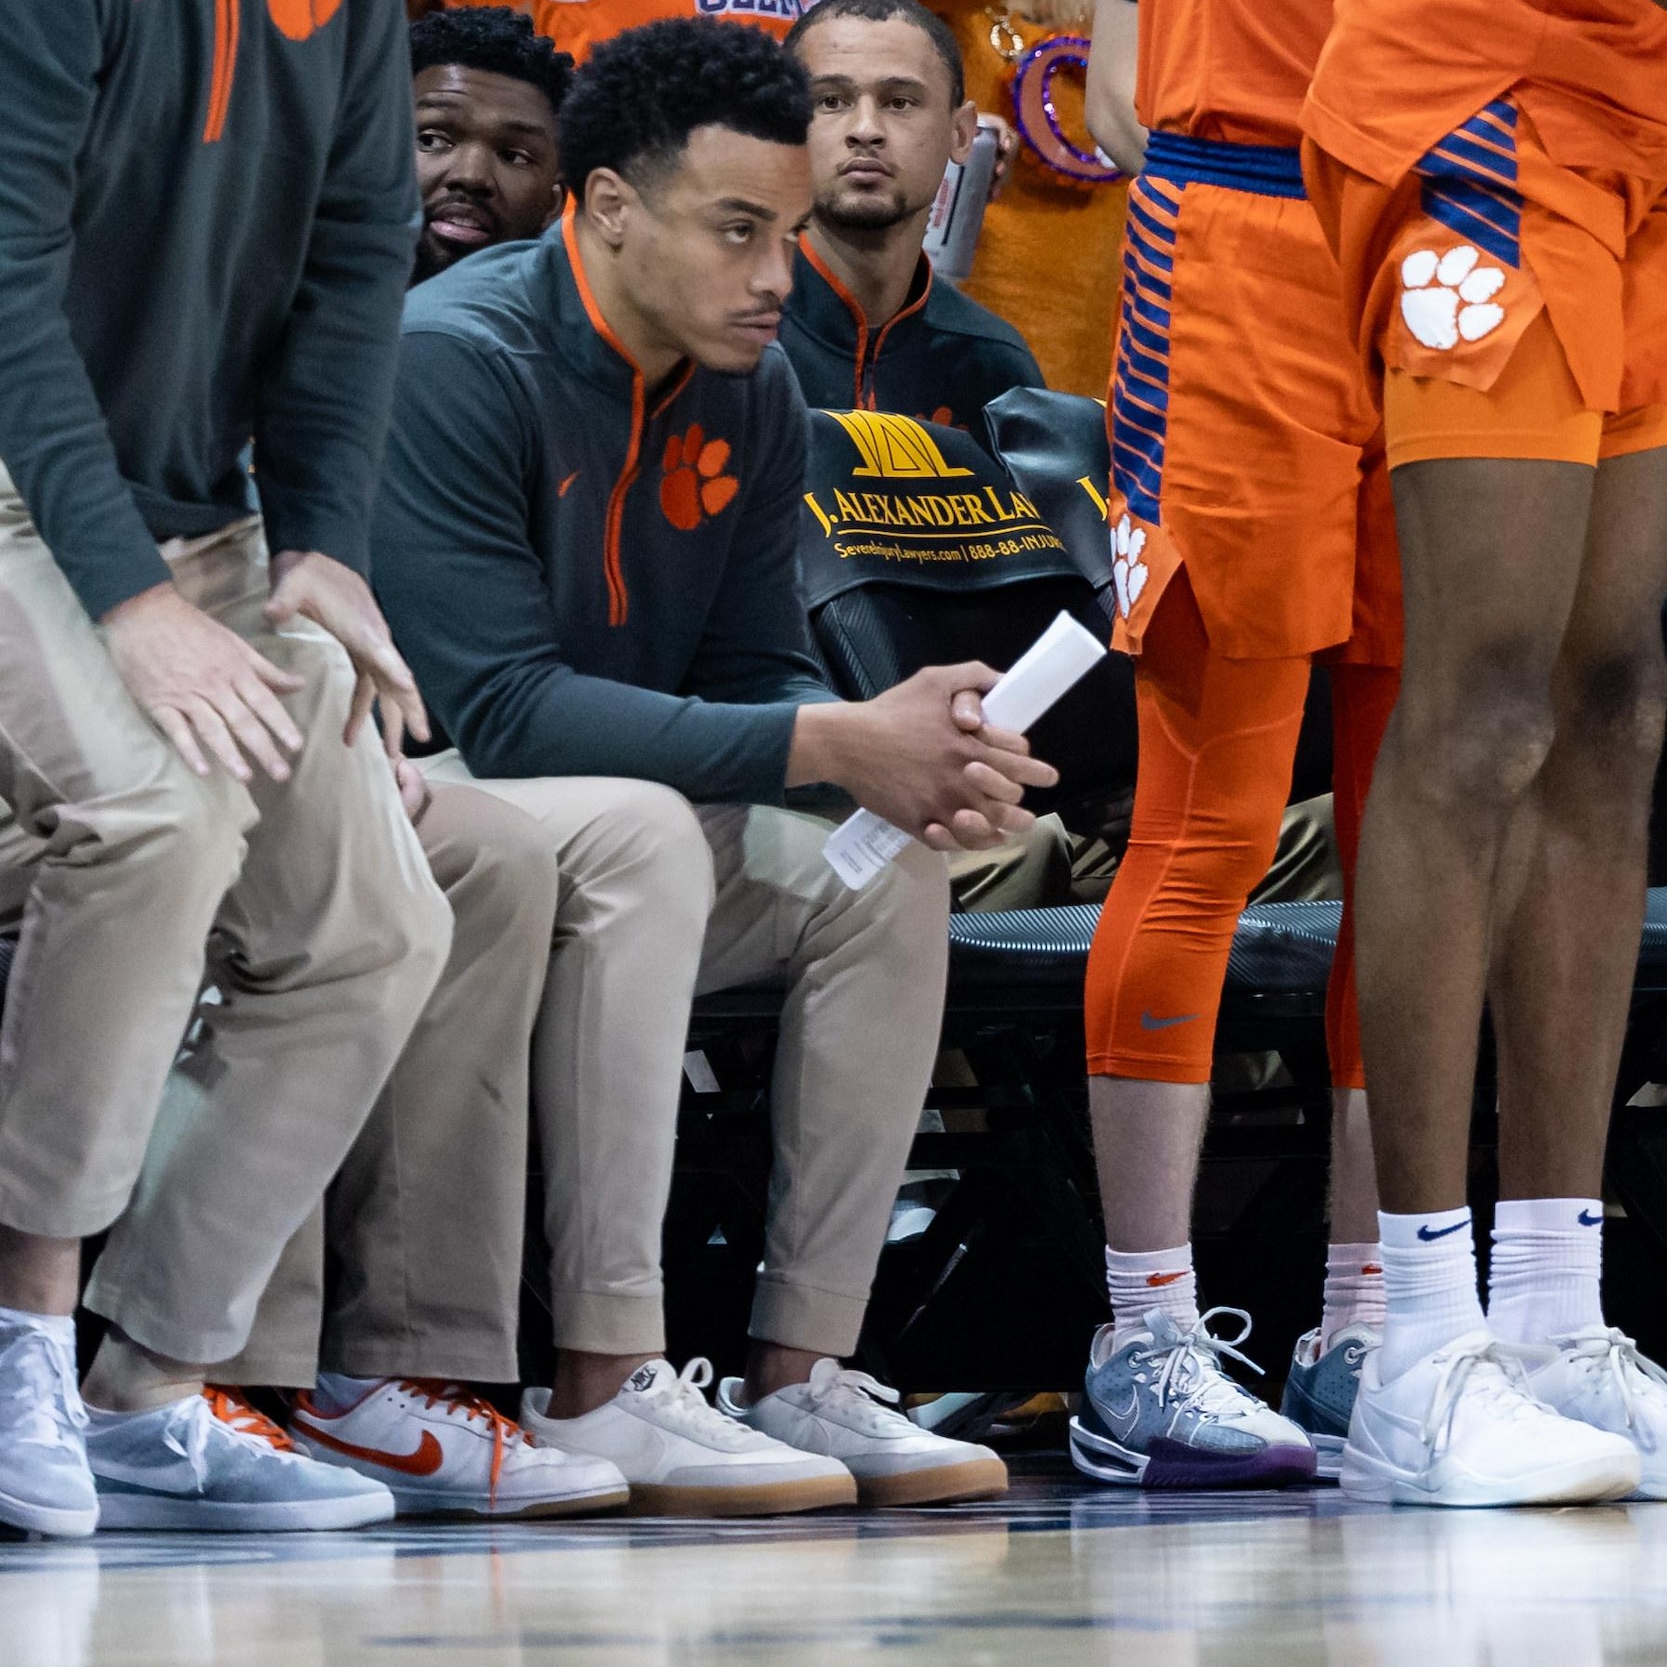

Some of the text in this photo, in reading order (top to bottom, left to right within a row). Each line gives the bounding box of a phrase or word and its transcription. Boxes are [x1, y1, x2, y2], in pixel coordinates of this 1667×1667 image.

[803, 492, 838, 538] J.
[833, 487, 998, 526] ALEXANDER
[968, 534, 1067, 560] 888-88-INJU
